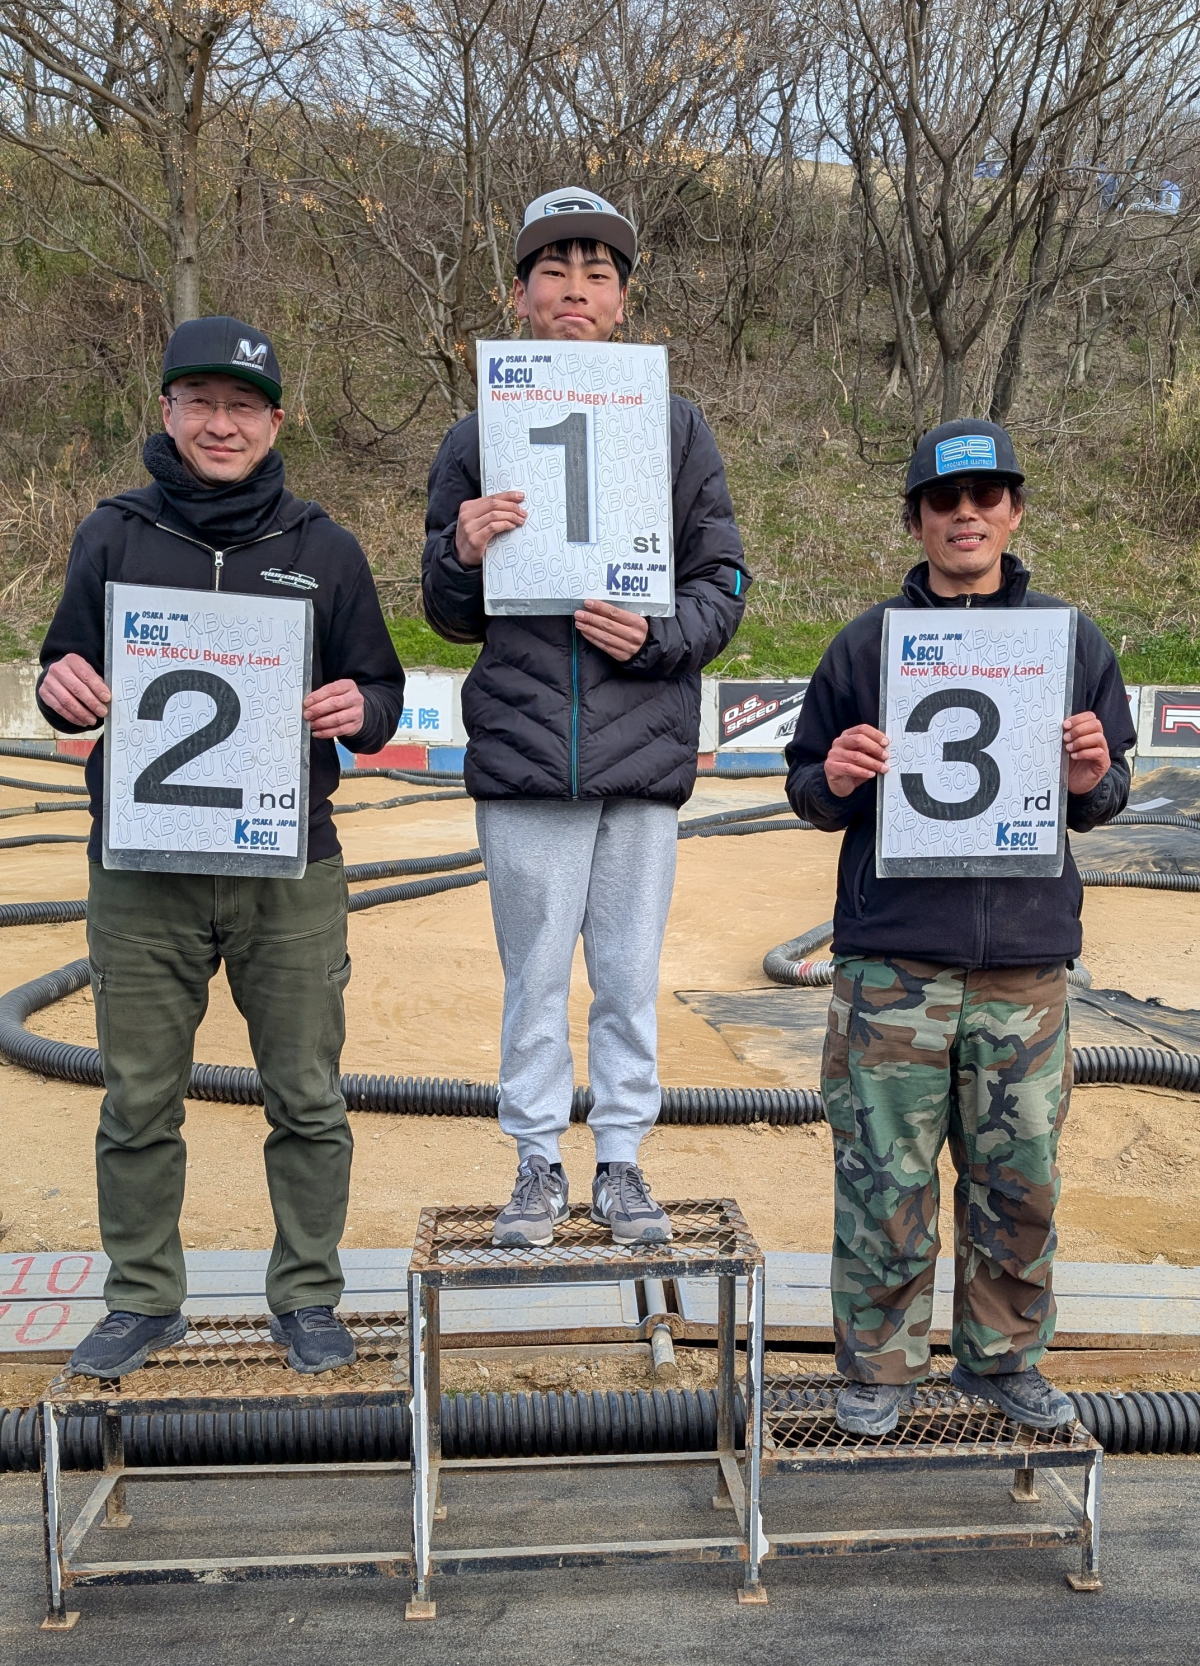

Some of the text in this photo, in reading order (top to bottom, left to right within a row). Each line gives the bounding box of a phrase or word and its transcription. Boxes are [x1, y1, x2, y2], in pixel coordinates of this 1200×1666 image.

[235, 339, 269, 365] M
[530, 355, 551, 363] JAPAN
[489, 357, 533, 384] KBCU
[491, 390, 643, 405] New KBCU Buggy Land
[529, 412, 590, 542] 1
[633, 533, 661, 554] st
[606, 563, 648, 592] KBCU
[622, 562, 667, 572] OSAKA JAPAN
[124, 612, 169, 641] KBCU
[141, 611, 189, 621] OSAKA JAPAN
[901, 635, 944, 661] KBCU
[919, 633, 963, 641] OSAKA JAPAN
[126, 644, 280, 667] New KBCU Buggy Land
[900, 664, 1044, 679] New KBCU Buggy Land
[724, 696, 762, 722] O.S.
[726, 701, 777, 734] SPEED
[134, 669, 243, 810] 2
[900, 687, 1000, 821] 3
[260, 788, 296, 810] nd
[1024, 790, 1051, 811] rd
[234, 819, 278, 846] KBCU
[252, 818, 297, 828] OSAKA JAPAN
[995, 822, 1037, 847] KBCU
[1012, 820, 1056, 828] OSAKA JAPAN
[1, 1255, 94, 1295] 10
[0, 1303, 71, 1345] 0
